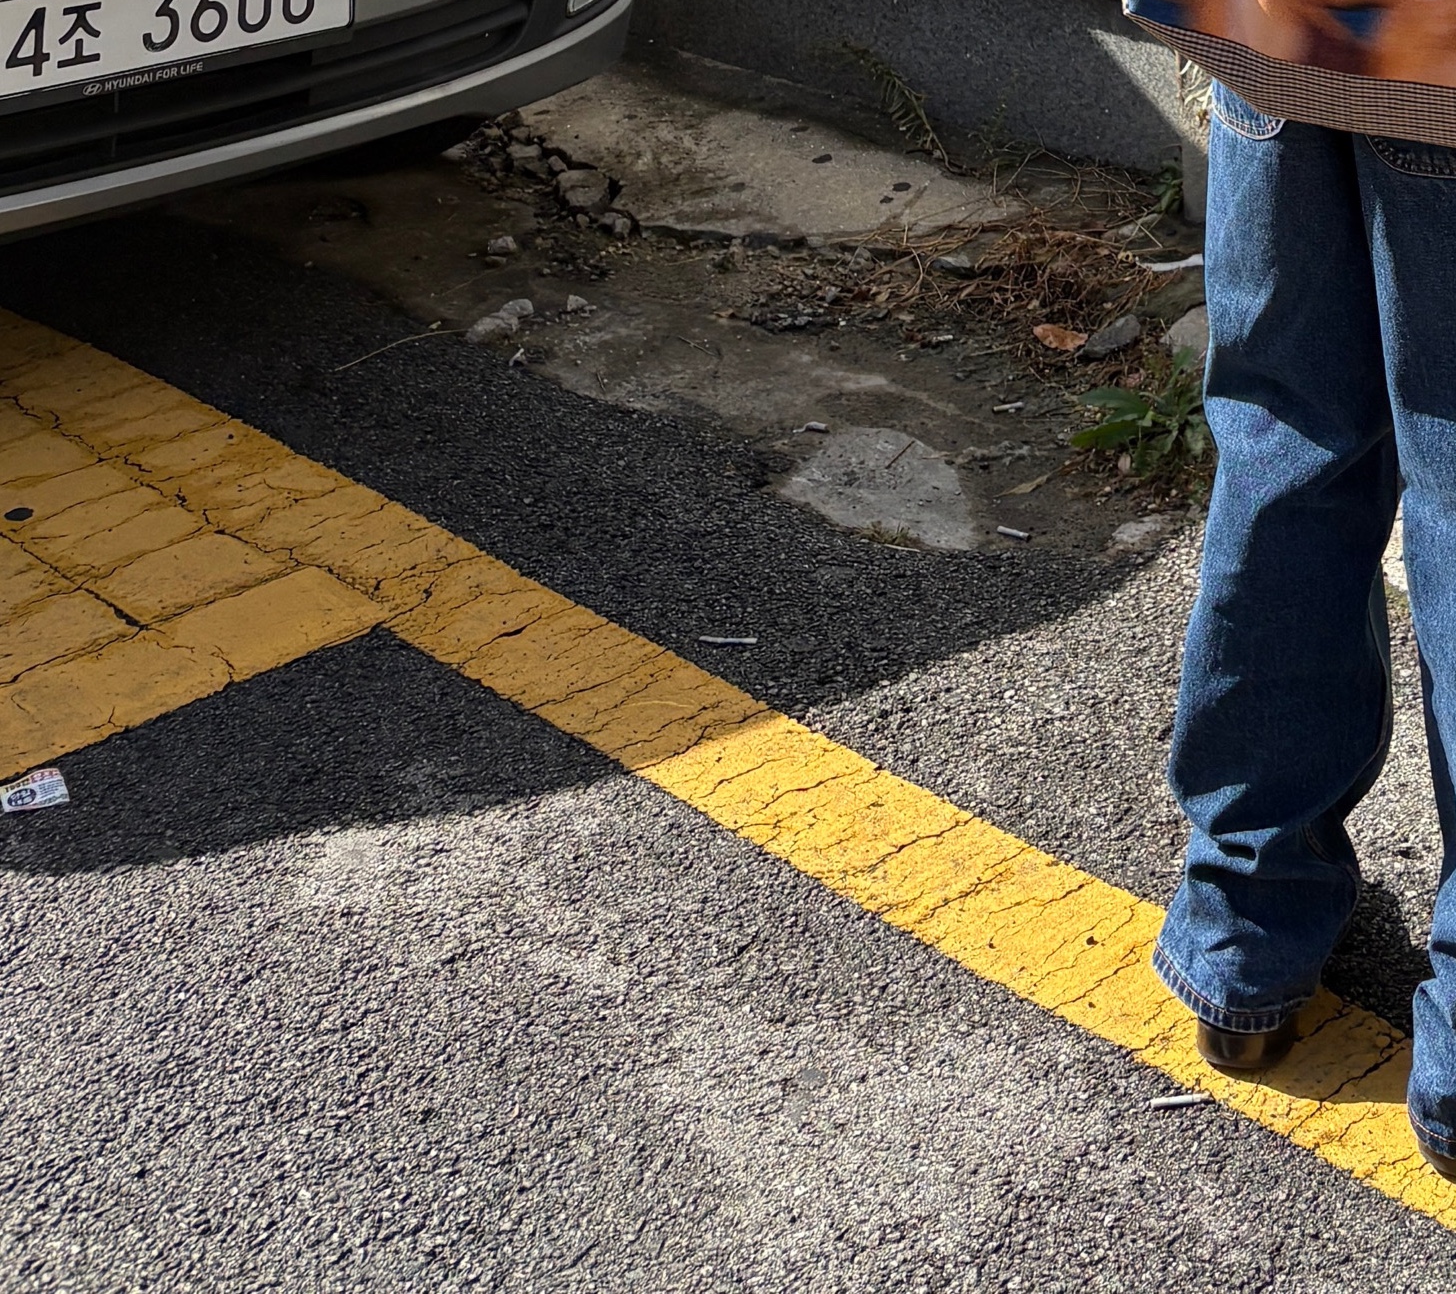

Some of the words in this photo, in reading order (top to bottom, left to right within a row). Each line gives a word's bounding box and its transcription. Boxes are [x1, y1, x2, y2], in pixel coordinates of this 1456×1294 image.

[5, 2, 101, 77] 4조
[105, 72, 153, 91] HYUNDAI
[156, 67, 178, 81] FOR
[180, 62, 204, 75] LIFE
